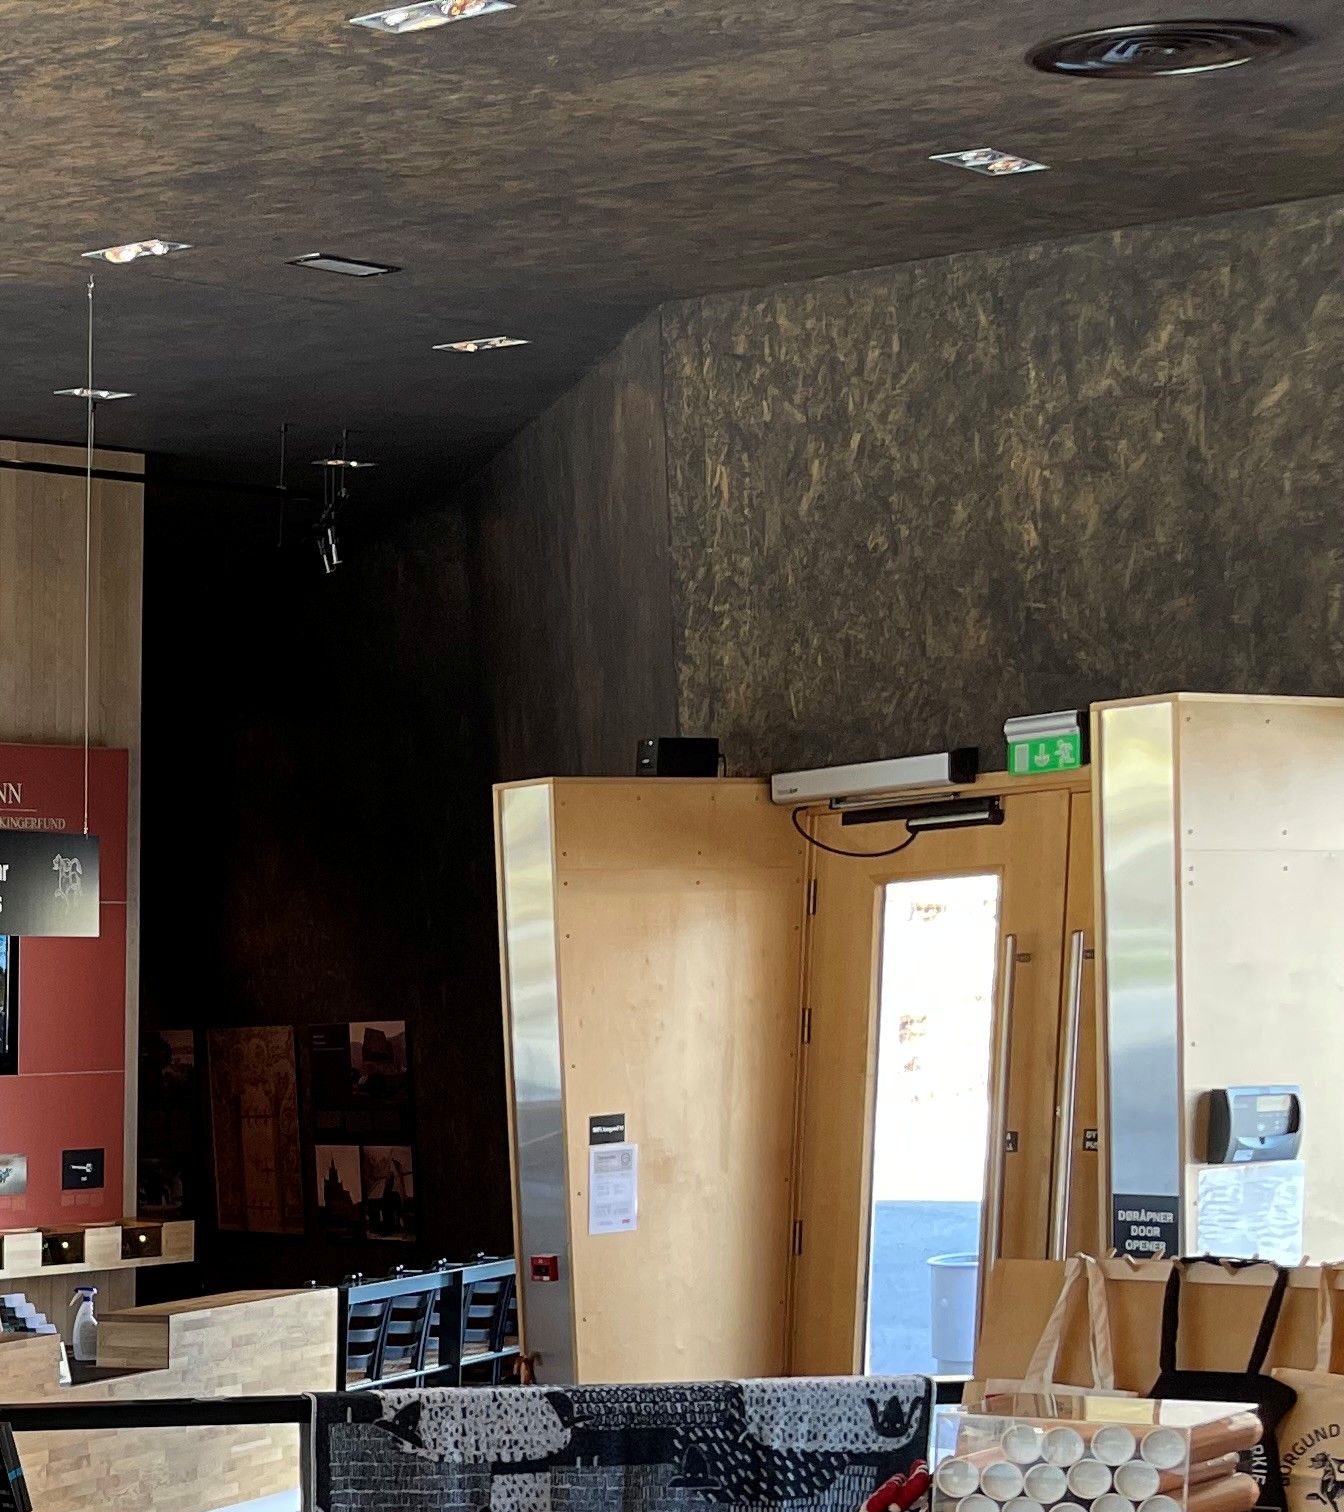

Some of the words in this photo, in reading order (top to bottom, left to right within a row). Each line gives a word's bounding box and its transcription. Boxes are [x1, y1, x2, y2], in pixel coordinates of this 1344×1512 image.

[1117, 1208, 1174, 1223] DØRÅPNER
[1130, 1225, 1161, 1237] DOOR
[1125, 1239, 1167, 1251] OPENER
